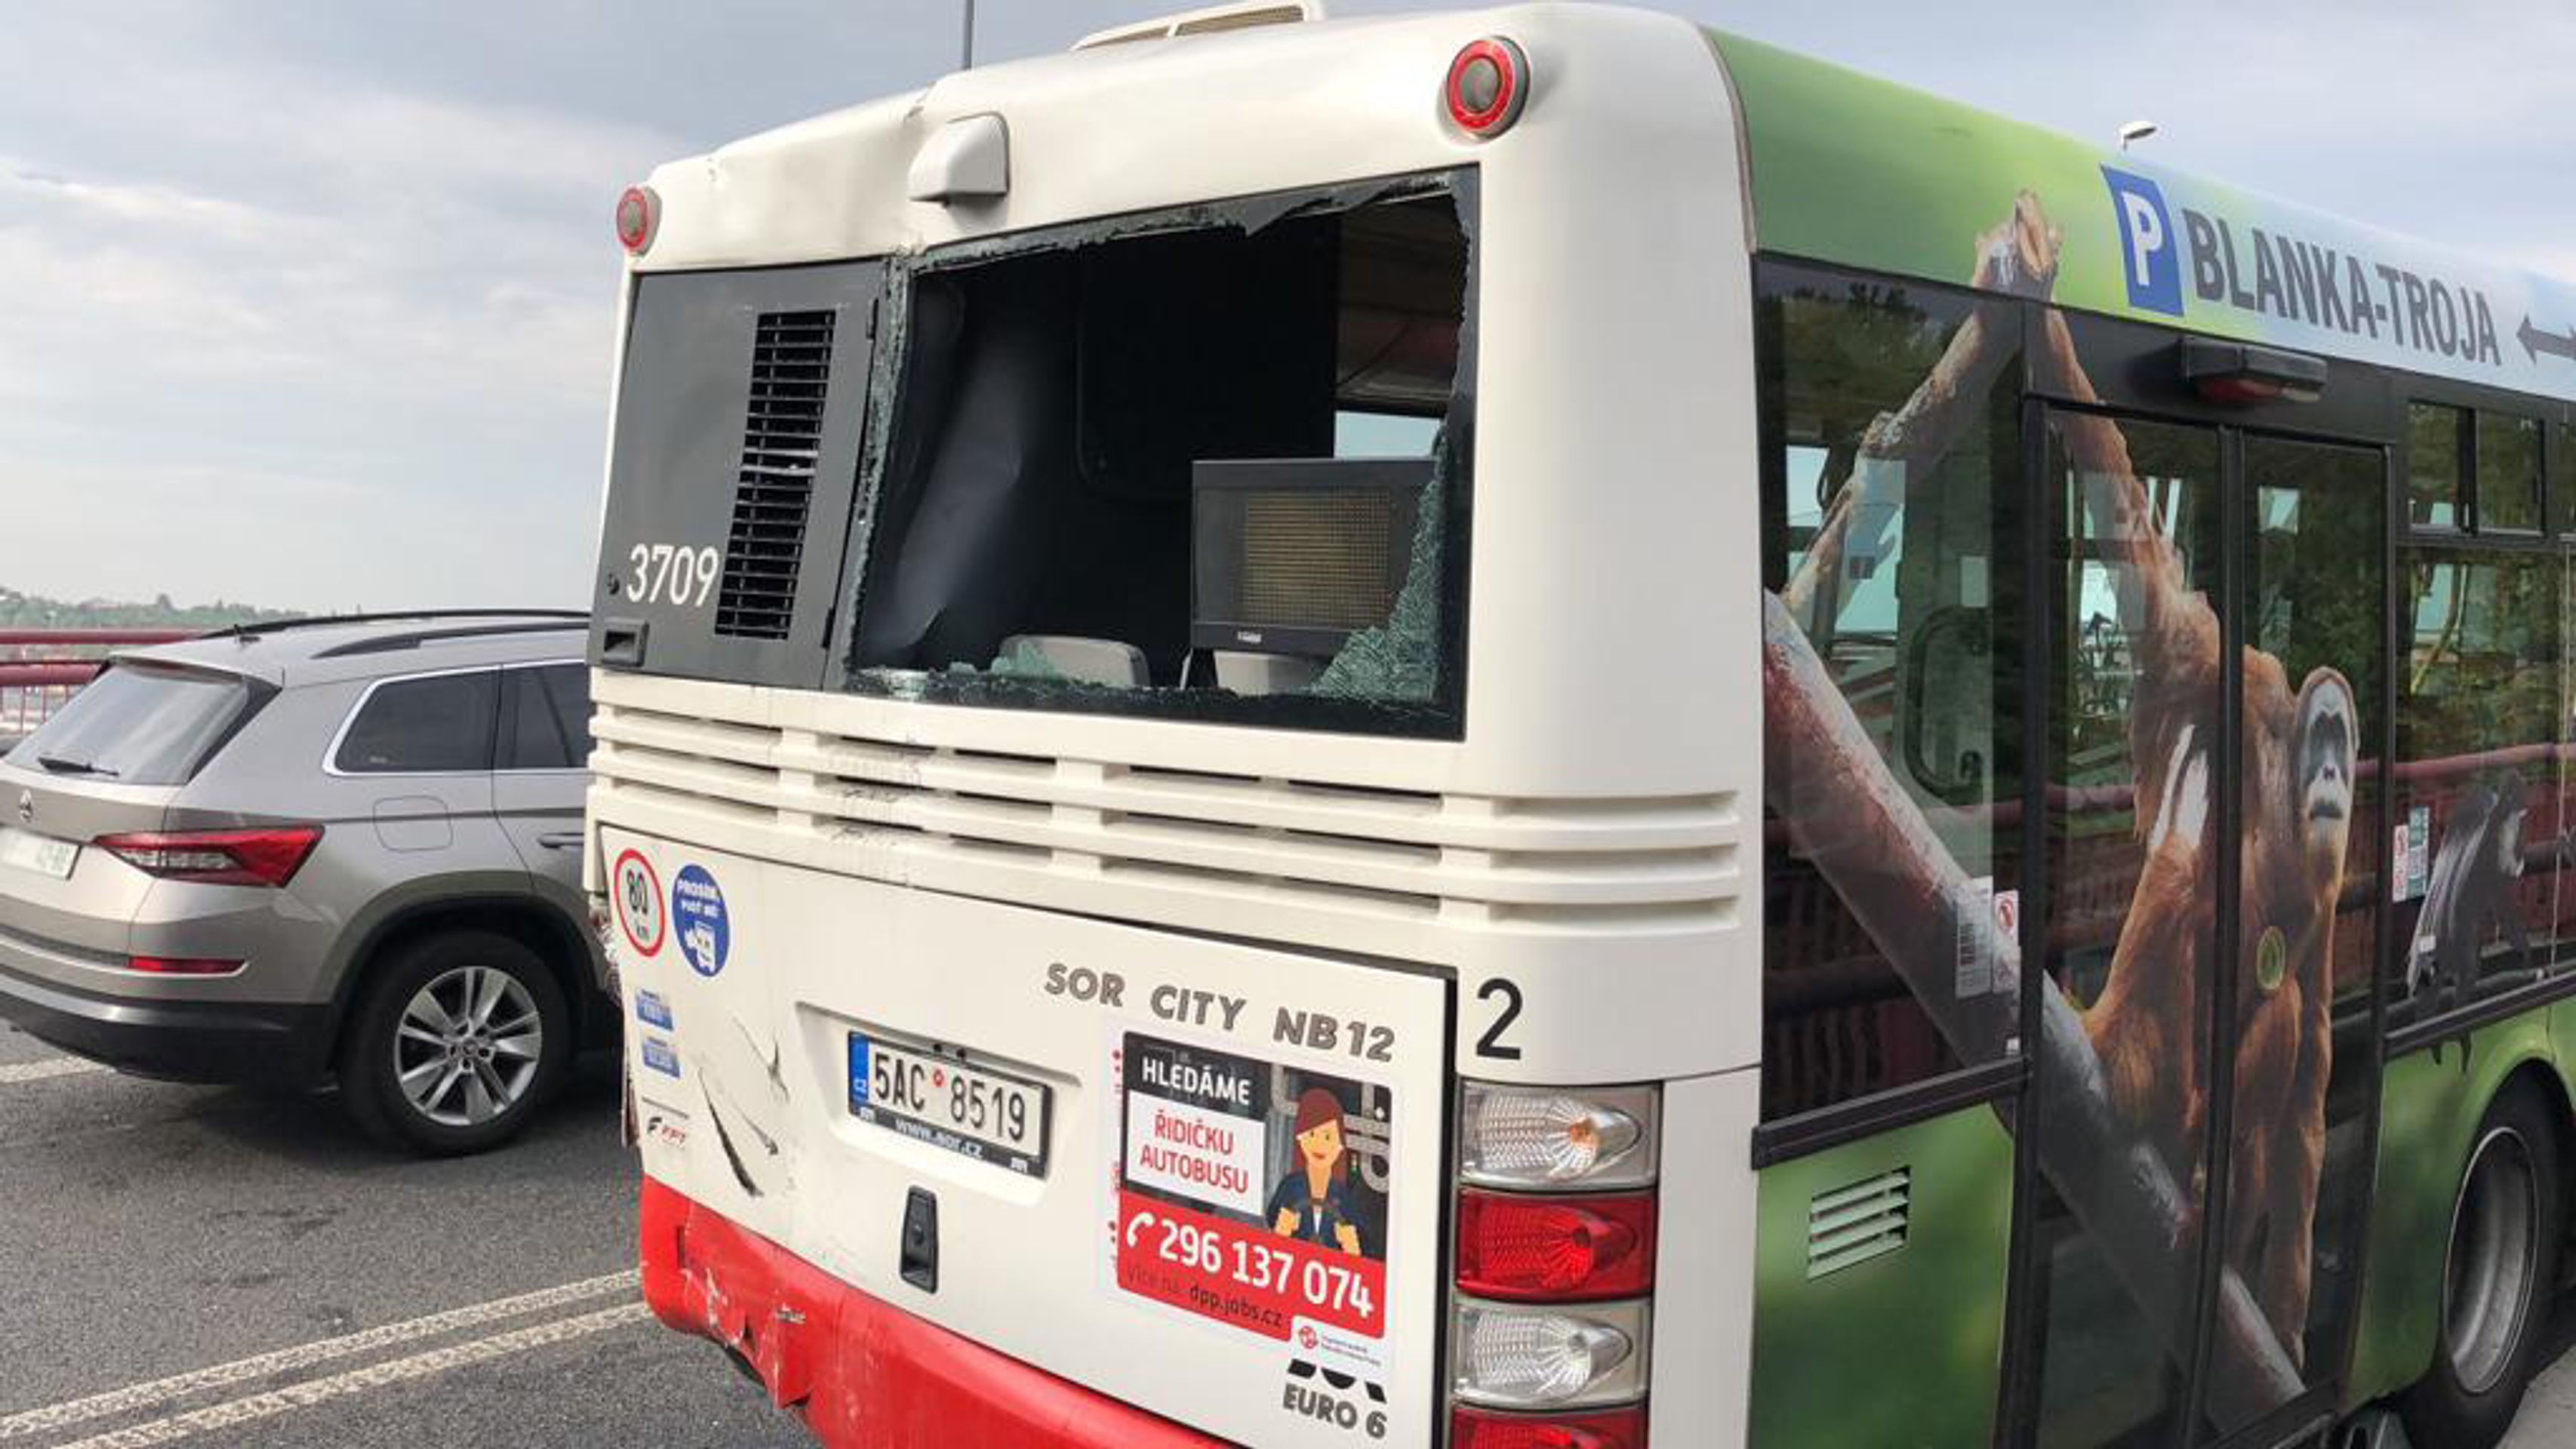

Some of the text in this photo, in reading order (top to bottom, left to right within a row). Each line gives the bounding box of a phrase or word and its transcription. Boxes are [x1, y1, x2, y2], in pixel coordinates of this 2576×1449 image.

[2183, 208, 2502, 366] BLANKA-TROJA
[626, 543, 719, 607] 3709
[626, 869, 648, 915] 80
[1044, 963, 1125, 1008] SOR
[1150, 984, 1247, 1032] CITY
[1476, 977, 1522, 1060] 2
[853, 1078, 867, 1094] CZ
[875, 1052, 1026, 1142] 5AC 8519
[1142, 1057, 1251, 1106] HLEDÁME
[1155, 1109, 1235, 1155] ŘIDIČKU
[1140, 1143, 1249, 1193] AUTOBUSU
[1159, 1218, 1374, 1318] 296 137 074
[1283, 1382, 1388, 1439] EURO 6
